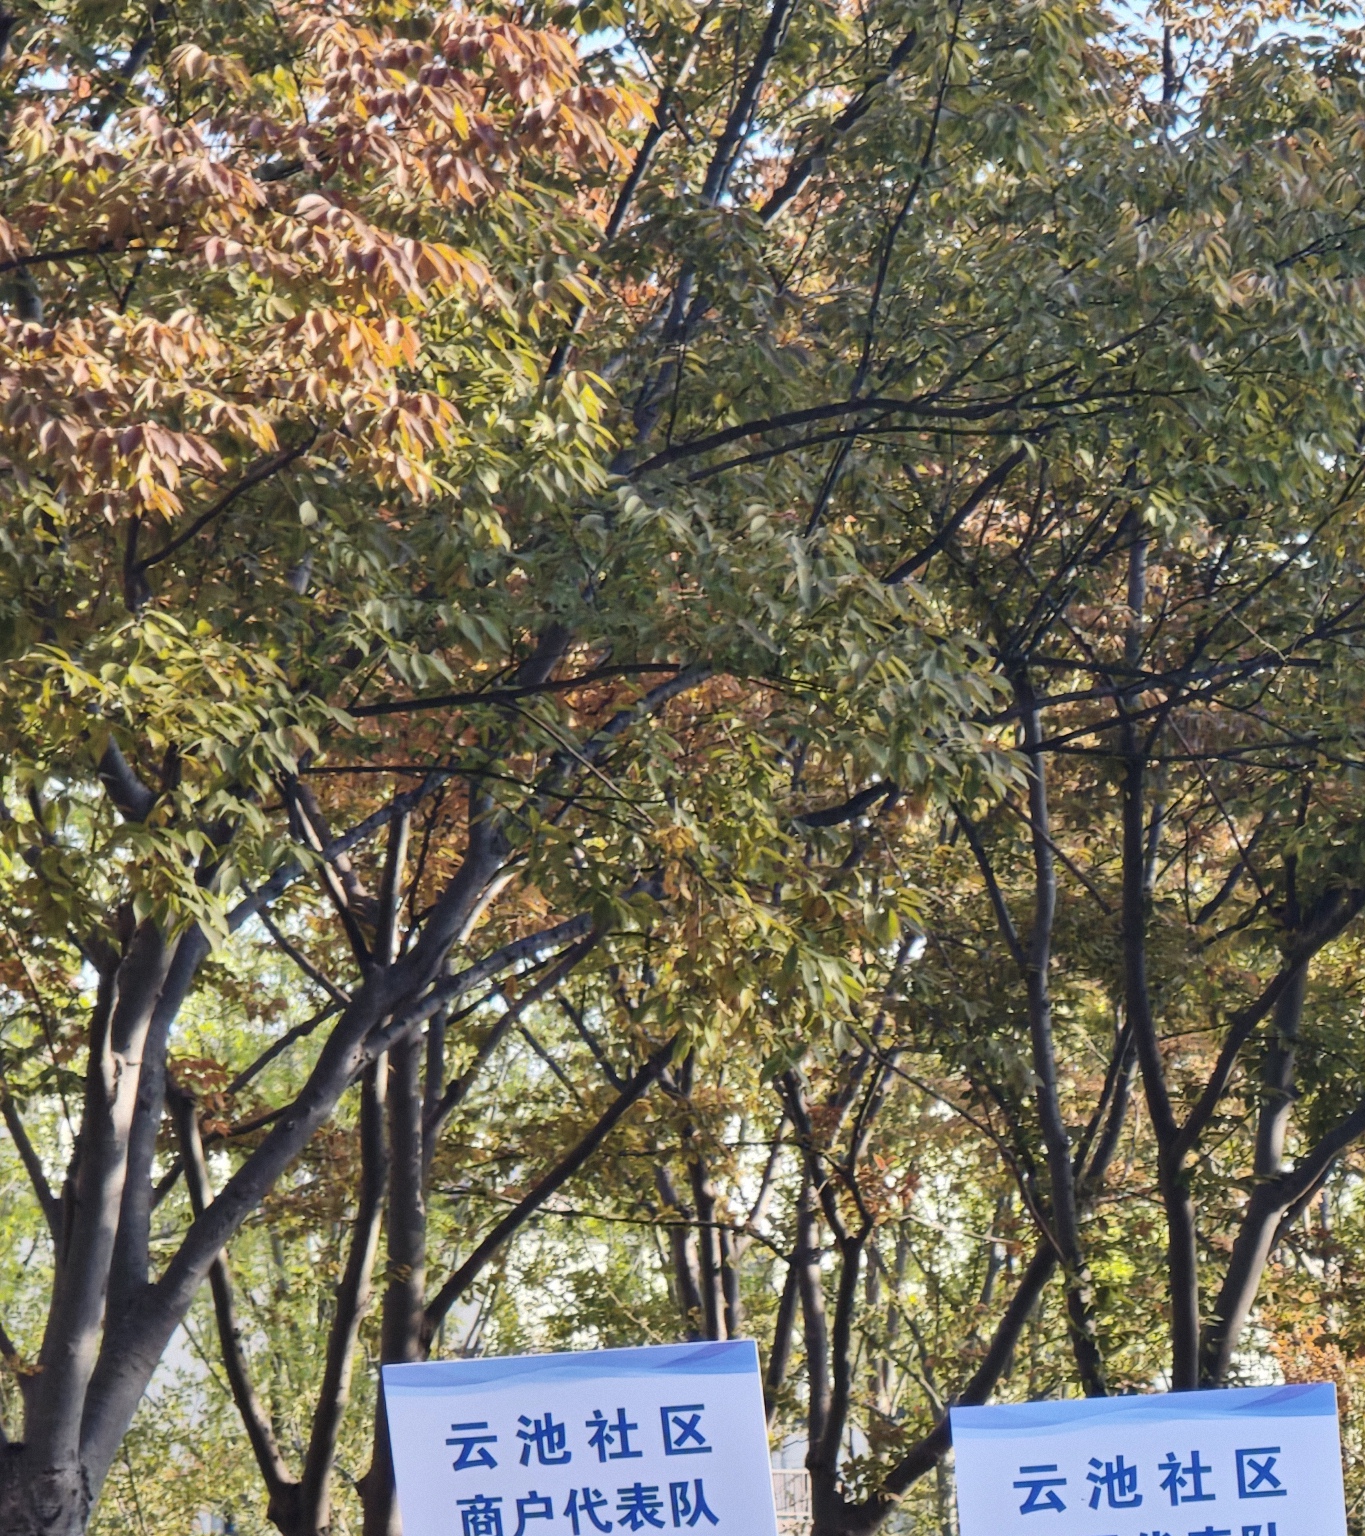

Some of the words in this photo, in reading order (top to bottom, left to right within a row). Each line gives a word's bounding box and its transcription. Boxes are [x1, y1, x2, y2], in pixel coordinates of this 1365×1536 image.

[446, 1404, 712, 1471] 云池社区
[1013, 1447, 1287, 1515] 云池社区
